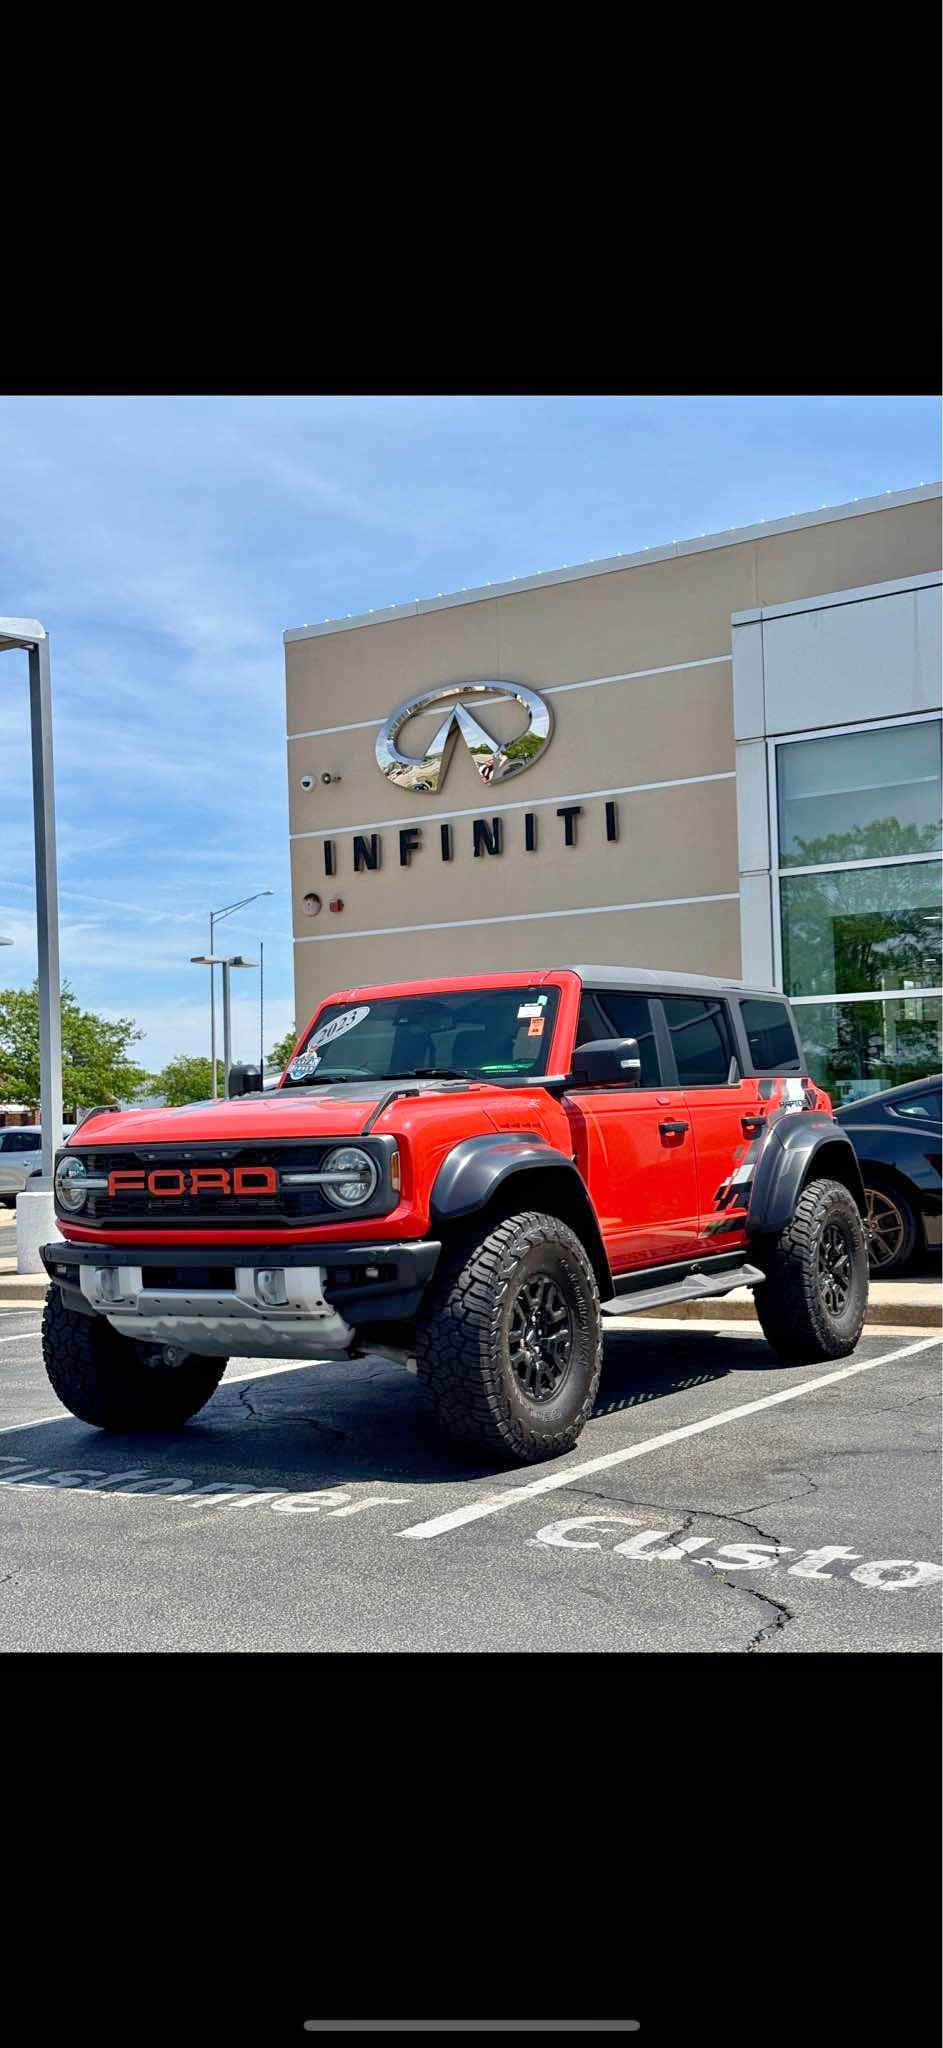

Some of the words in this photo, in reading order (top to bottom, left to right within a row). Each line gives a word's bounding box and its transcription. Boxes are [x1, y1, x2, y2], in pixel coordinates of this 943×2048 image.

[323, 801, 619, 876] INFINITI
[317, 1011, 358, 1043] 2023
[107, 1166, 278, 1197] FORD
[0, 1456, 413, 1516] ustomer
